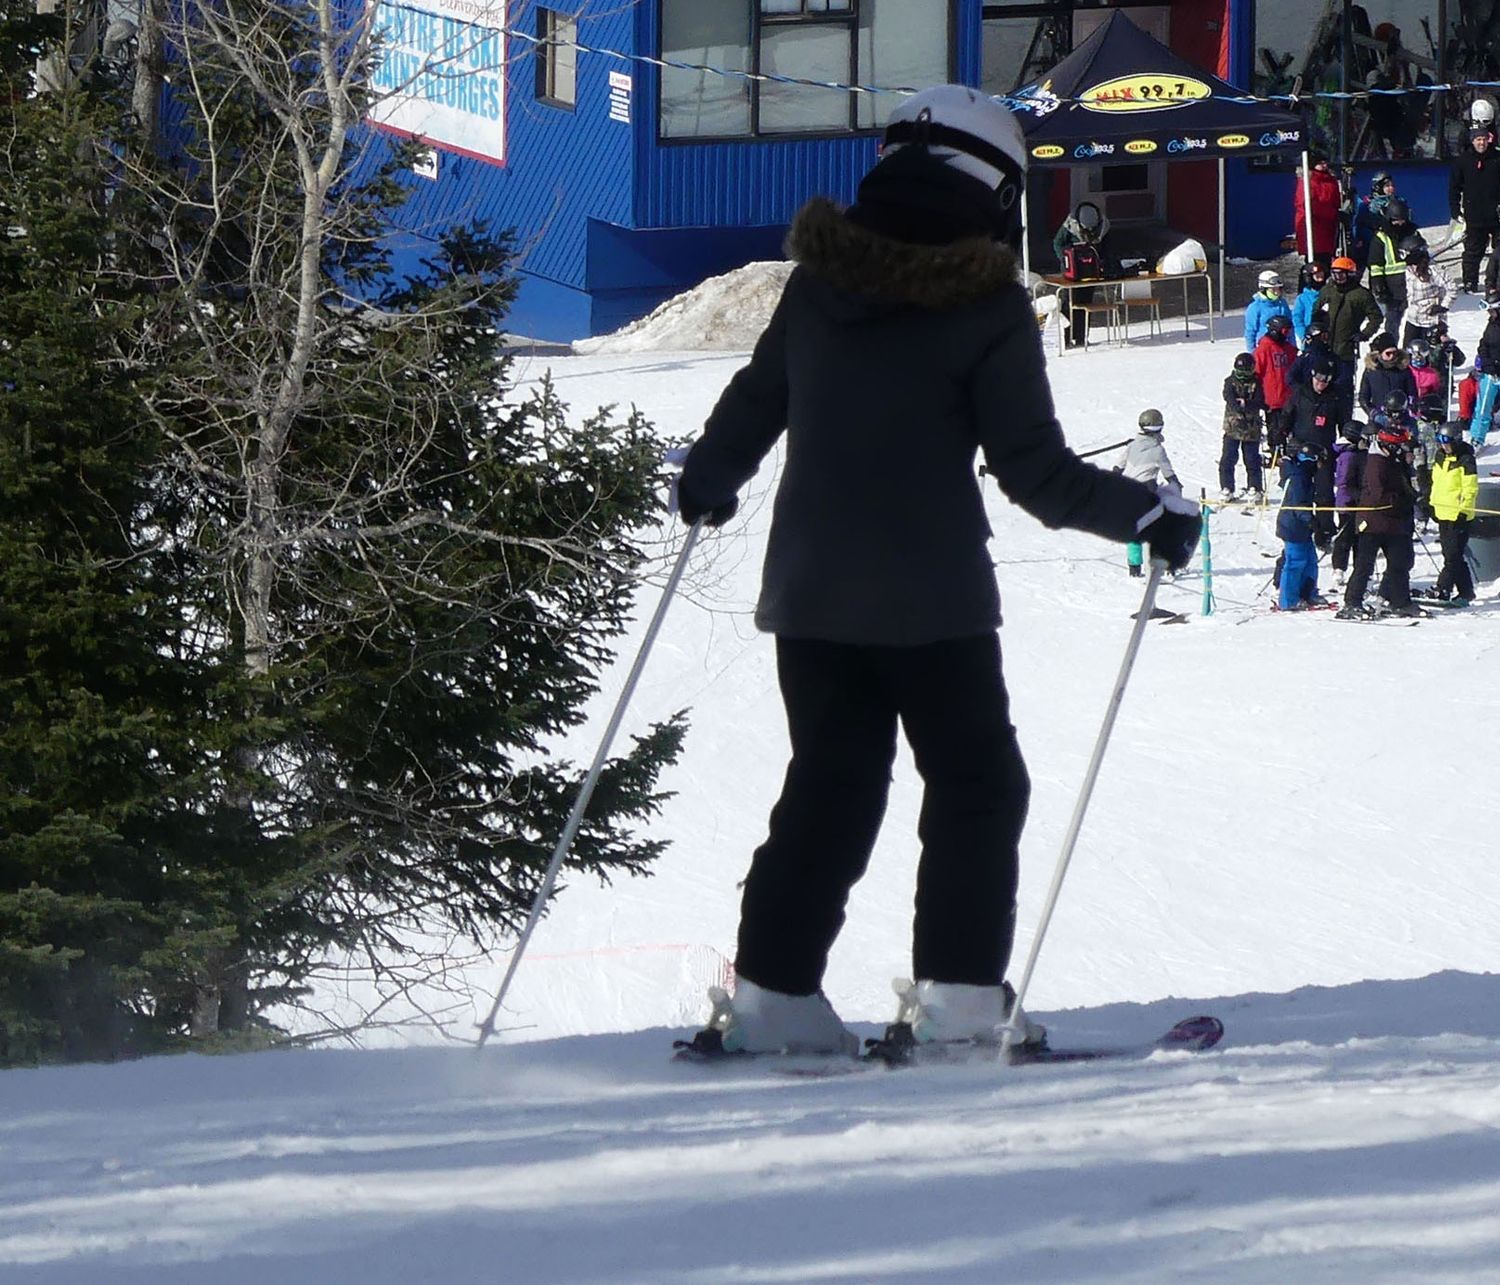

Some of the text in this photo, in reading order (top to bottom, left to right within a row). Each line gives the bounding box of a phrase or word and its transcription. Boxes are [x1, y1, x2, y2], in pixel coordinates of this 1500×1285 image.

[374, 1, 498, 73] CENTRE DE SKI
[373, 47, 499, 121] SAINT-GEORGES
[1096, 87, 1133, 101] MIX
